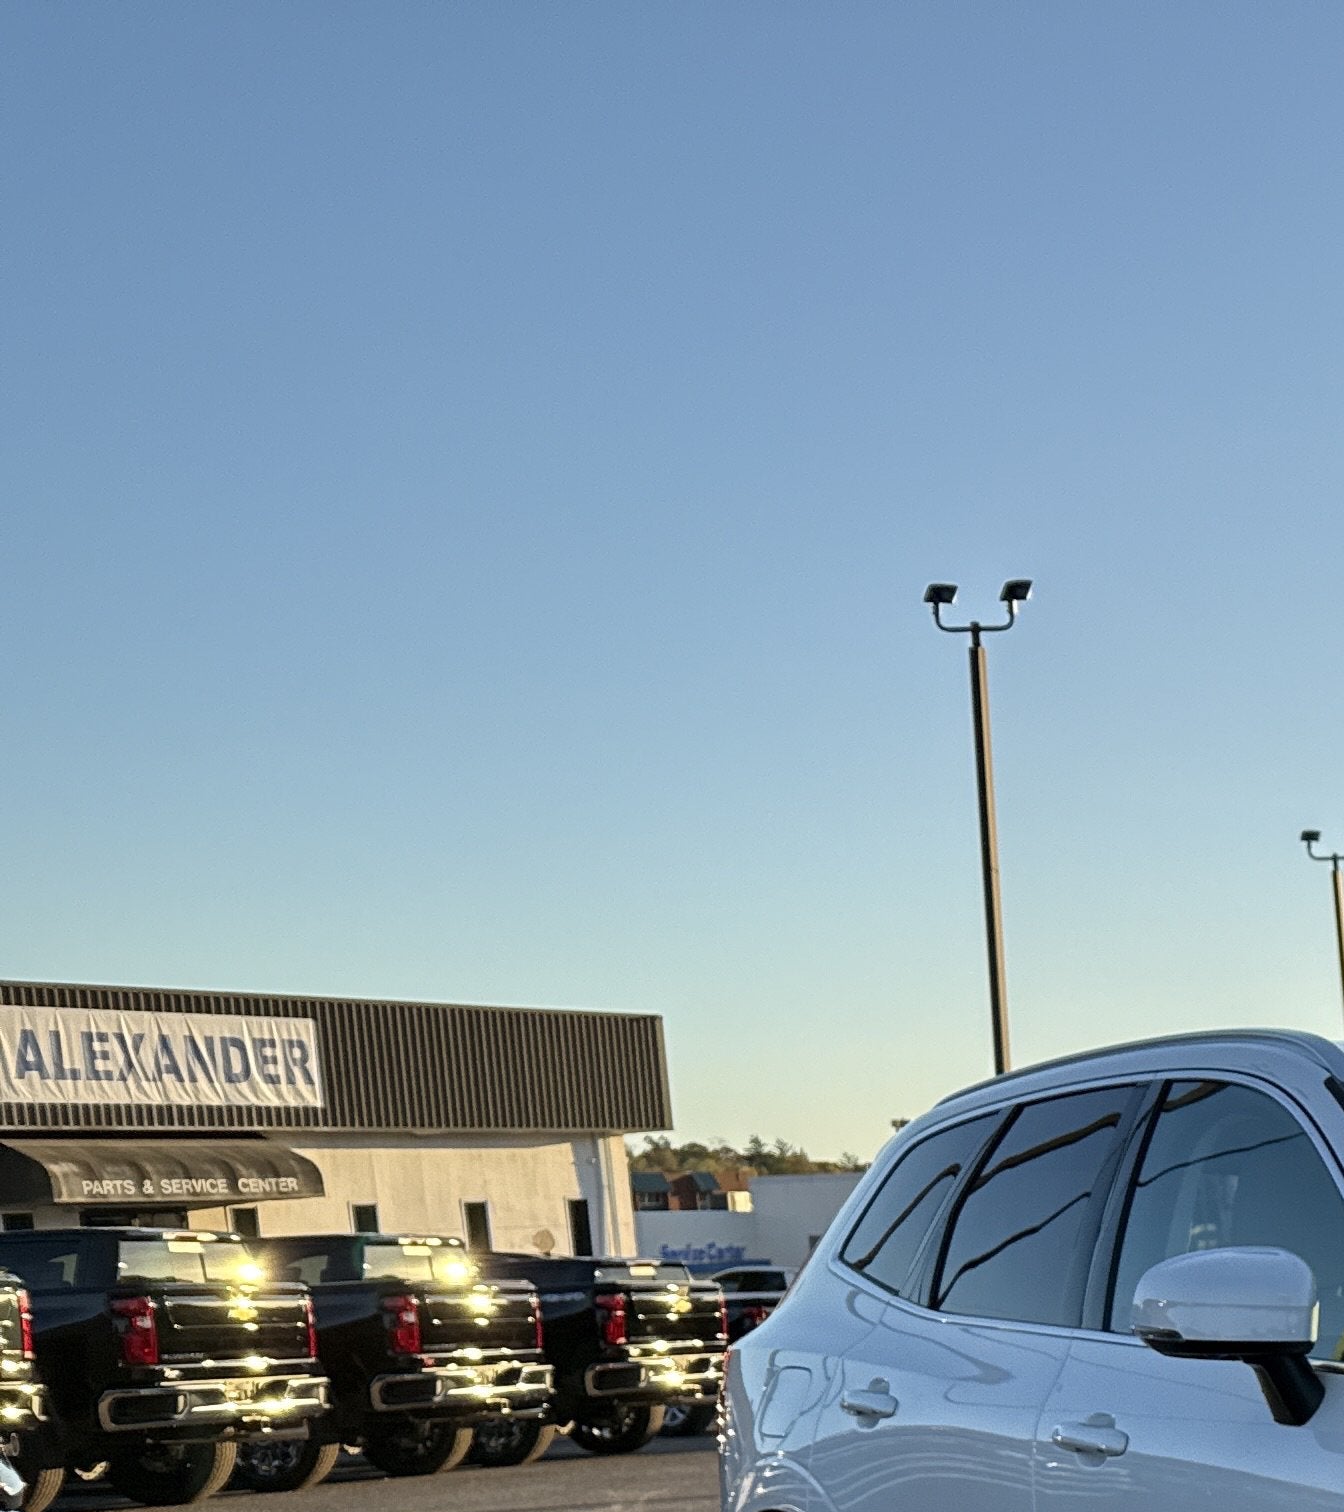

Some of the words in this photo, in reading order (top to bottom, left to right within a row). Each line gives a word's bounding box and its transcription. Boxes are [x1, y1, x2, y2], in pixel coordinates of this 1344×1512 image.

[15, 1028, 316, 1086] ALEXANDER
[82, 1179, 136, 1195] PARTS
[142, 1179, 154, 1194] &
[160, 1177, 229, 1194] SERVICE
[237, 1176, 298, 1193] CENTER
